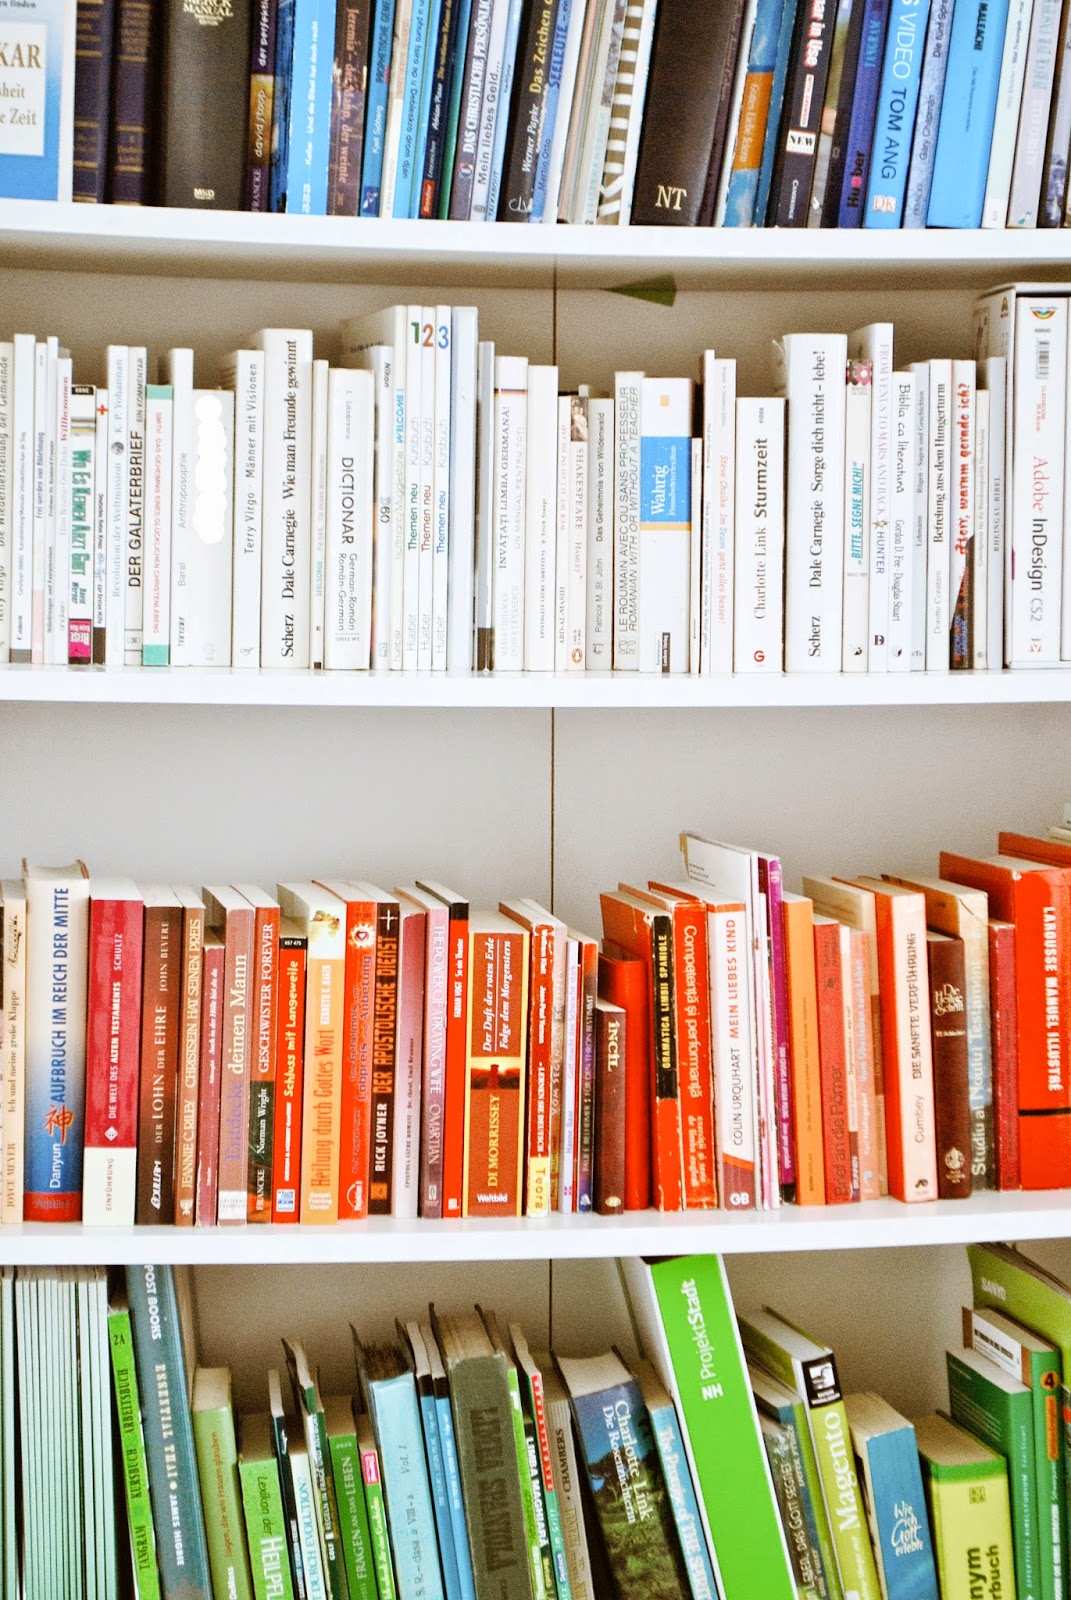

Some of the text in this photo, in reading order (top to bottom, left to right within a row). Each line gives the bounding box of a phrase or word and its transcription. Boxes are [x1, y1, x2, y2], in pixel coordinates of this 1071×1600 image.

[184, 3, 234, 17] MANUAL
[531, 9, 553, 64] Zeichen
[805, 38, 822, 67] Use
[973, 2, 989, 51] MALEACHI
[10, 108, 37, 126] Zeit
[338, 8, 362, 184] Jeremia weinte
[461, 59, 484, 153] DAS CHRISTLICHE
[476, 60, 500, 185] Mein liebes Geld...
[528, 68, 544, 94] Das
[537, 25, 567, 190] Martin Otto SEELEUTE
[881, 12, 918, 181] VIDEO TOM ANG
[918, 94, 936, 160] Gary Chapman
[520, 136, 535, 172] Werner
[788, 134, 814, 148] NEW
[655, 184, 688, 210] NT
[787, 178, 800, 219] CAMBRIDGE
[382, 362, 392, 388] Nikon
[409, 321, 421, 343] 1
[421, 323, 434, 347] 2
[436, 325, 449, 349] 3
[596, 412, 606, 460] Wildenwald
[896, 384, 911, 419] Biblia
[128, 357, 145, 588] DER GALATERBRIEF KOMMENTAR
[243, 362, 257, 554] Terry Virgo Männer mit Visionen
[281, 339, 299, 657] Scherz Dale Carnegie Wie man Freunde gewinnt
[595, 480, 605, 524] Geheimnis
[619, 387, 630, 615] ROUMAIN PROFESSEUR
[650, 465, 667, 515] Wahrig
[807, 350, 826, 657] Scherz Dale Carnegie Sorge dich nicht lebe!
[932, 383, 947, 543] Befreiung Hungerturm
[956, 462, 969, 509] warum
[406, 482, 419, 550] Themen neu
[595, 525, 605, 542] Das
[753, 437, 769, 620] Charlotte Link Sturmzeit
[875, 531, 886, 574] HUNTER
[1028, 455, 1049, 622] Adobe InDesign CS2
[8, 990, 19, 1021] Klappe
[186, 919, 200, 1019] HAT SEINEN PREIS
[227, 954, 247, 1075] deinen Mann
[481, 938, 496, 1052] Der Duft der roten Erde
[498, 941, 514, 1049] Folge dem Morgenstern
[657, 934, 671, 1069] GRAMATICA LIMBII SPANIOLE
[1042, 906, 1064, 1091] LAROUSSE MANUEL ILLUSTRÉ
[49, 888, 69, 1189] Danyun AUFBRUCH IM REICH DER MITTE
[108, 933, 123, 1104] WELT ALTEN TESTAMENTS SCHULTZ
[151, 921, 169, 1120] LOHN EHRE JOHN BEVERE
[256, 923, 273, 1154] Norman Wright GESCHWISTER FOREVER
[282, 960, 300, 1097] Schluss mit Langeweile
[372, 935, 397, 1172] RICK JOYNER DER DIENST
[723, 919, 744, 1146] COLIN URQUHART MEIN LIEBES KIND
[309, 1028, 335, 1187] Heilung durch Gottes Wort
[487, 1094, 500, 1169] MORRISSEY
[971, 1121, 988, 1176] Studiu
[476, 1194, 508, 1203] Weltbild
[679, 1278, 717, 1379] ProjektStadt
[980, 1276, 1006, 1301] SANYO
[116, 1367, 150, 1571] TANGRAM KURSBUCH ARBEITSBUCH
[147, 1296, 185, 1566] BOOKS ESSENTIAL THAI JAMES HIGBIE
[525, 1436, 539, 1477] LIMBA
[554, 1428, 573, 1493] CHAMBERS
[601, 1405, 639, 1524] Die Rosenzüchterin
[613, 1399, 655, 1521] Charlotte Link
[824, 1410, 862, 1533] Magento
[256, 1476, 271, 1516] Lexikon
[296, 1476, 316, 1548] EVOLUTION?
[340, 1455, 368, 1579] FRAGEN LEBEN
